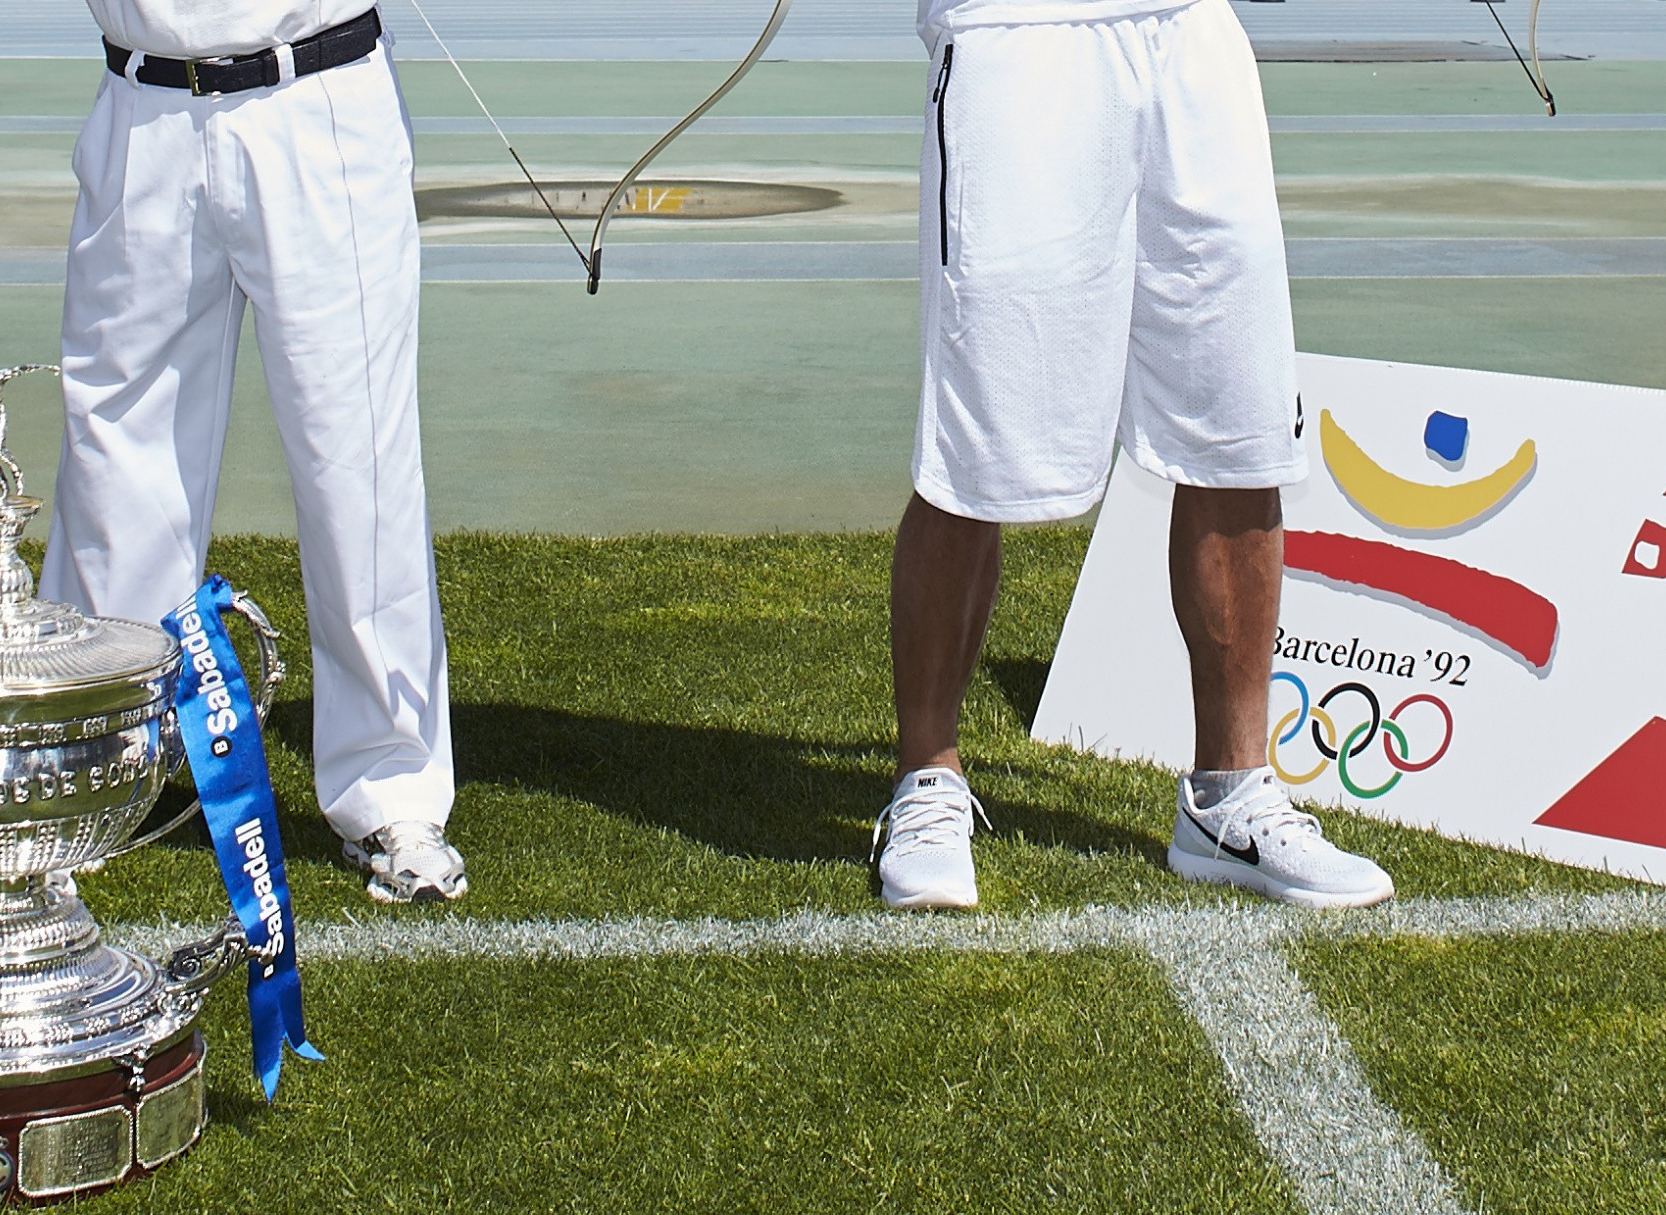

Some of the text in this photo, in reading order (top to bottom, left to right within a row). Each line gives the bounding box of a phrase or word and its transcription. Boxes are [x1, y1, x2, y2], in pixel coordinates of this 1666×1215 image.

[175, 595, 237, 735] Sabadell
[1273, 626, 1416, 679] Barcelona
[918, 777, 938, 788] NIKE
[235, 817, 285, 957] Sabadell
